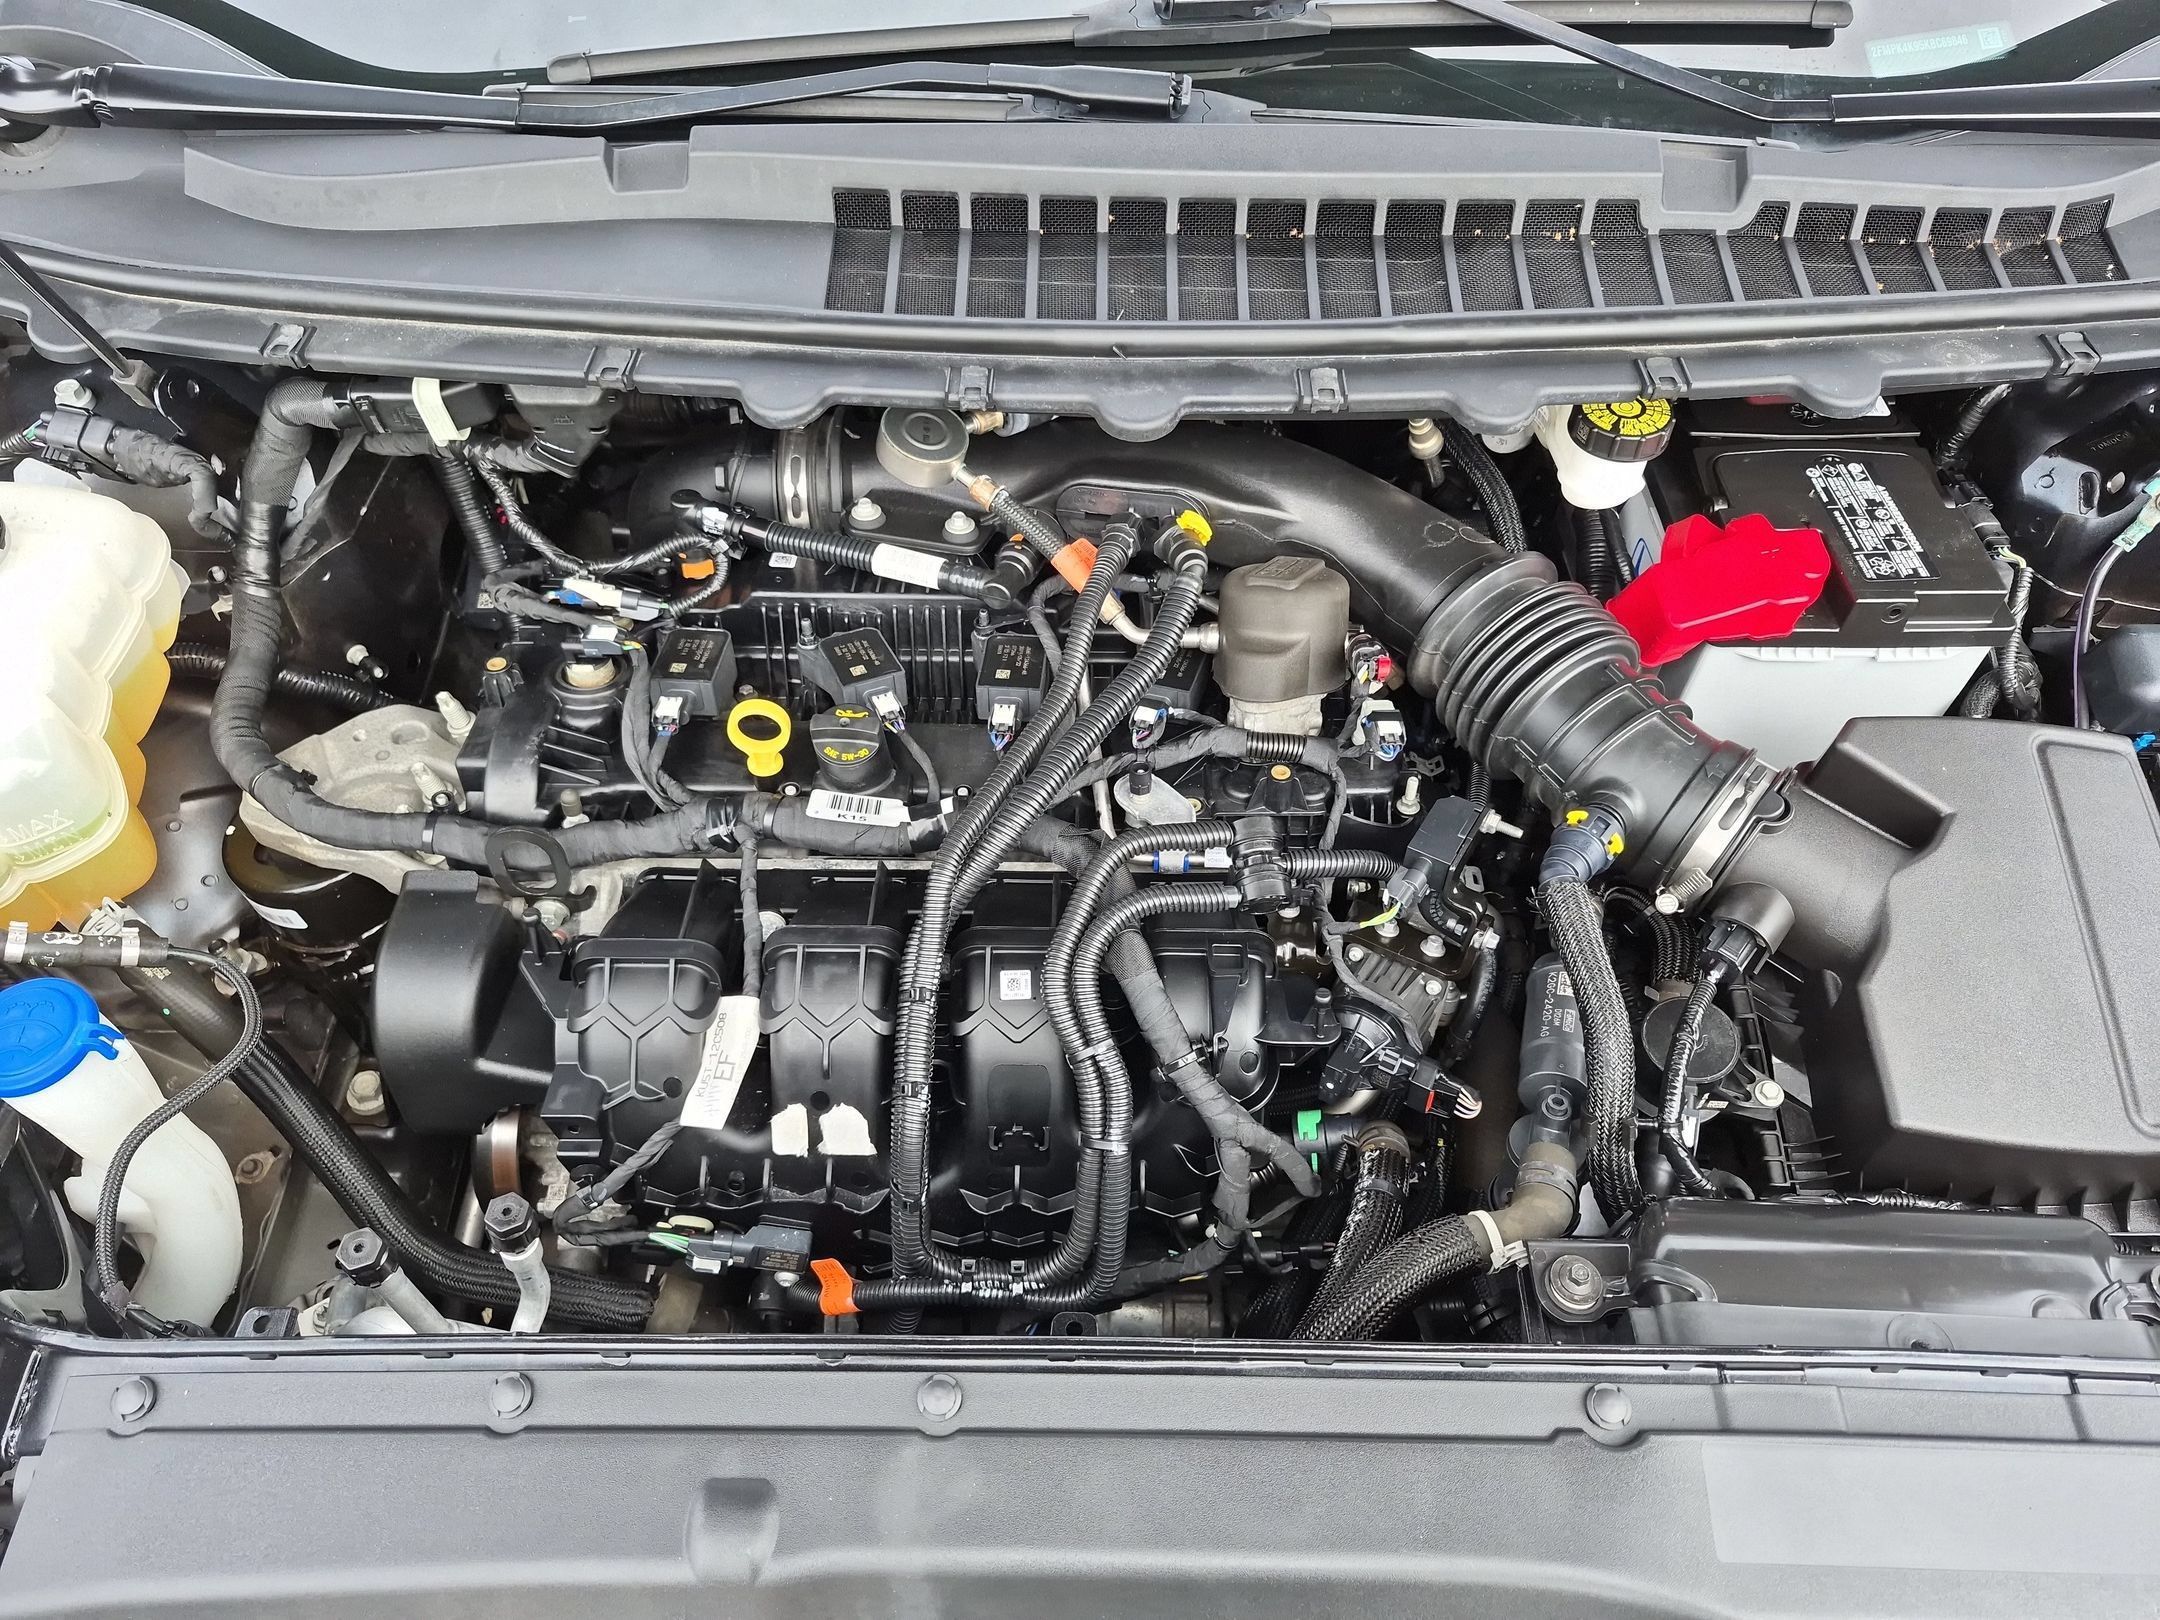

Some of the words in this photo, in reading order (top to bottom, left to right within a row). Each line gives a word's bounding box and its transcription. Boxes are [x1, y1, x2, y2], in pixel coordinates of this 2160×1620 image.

[823, 746, 840, 759] SAE
[841, 748, 869, 761] 5W-30
[6, 809, 67, 842] MAX
[837, 813, 867, 822] K15
[713, 1050, 738, 1081] EF
